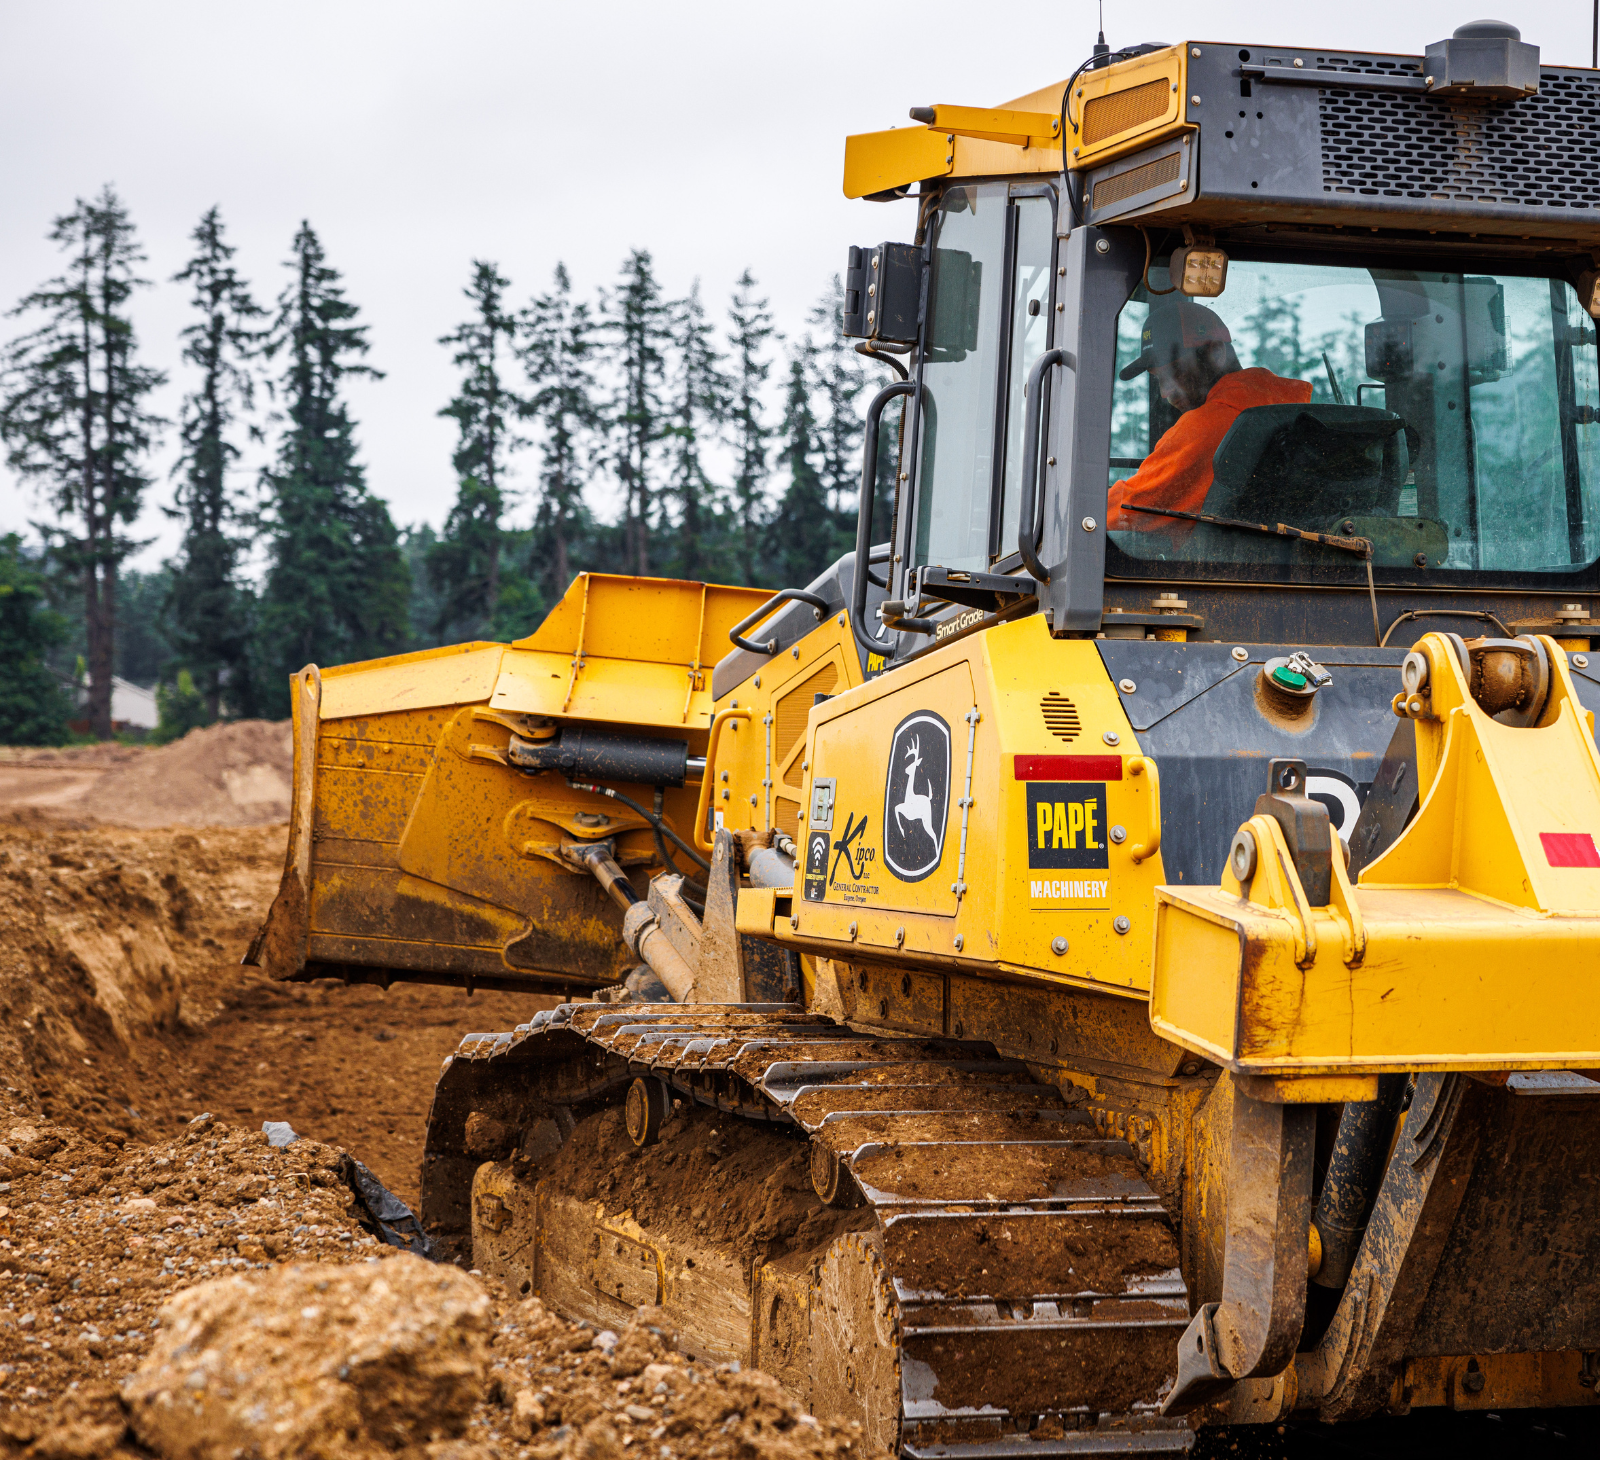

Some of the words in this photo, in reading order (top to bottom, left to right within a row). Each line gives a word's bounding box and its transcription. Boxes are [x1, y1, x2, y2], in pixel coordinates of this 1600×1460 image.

[936, 617, 960, 640] Smart
[960, 608, 984, 629] Grade
[833, 881, 851, 892] GENERAL
[852, 883, 879, 894] CONTRACTOR
[1030, 880, 1108, 899] MACHINERY
